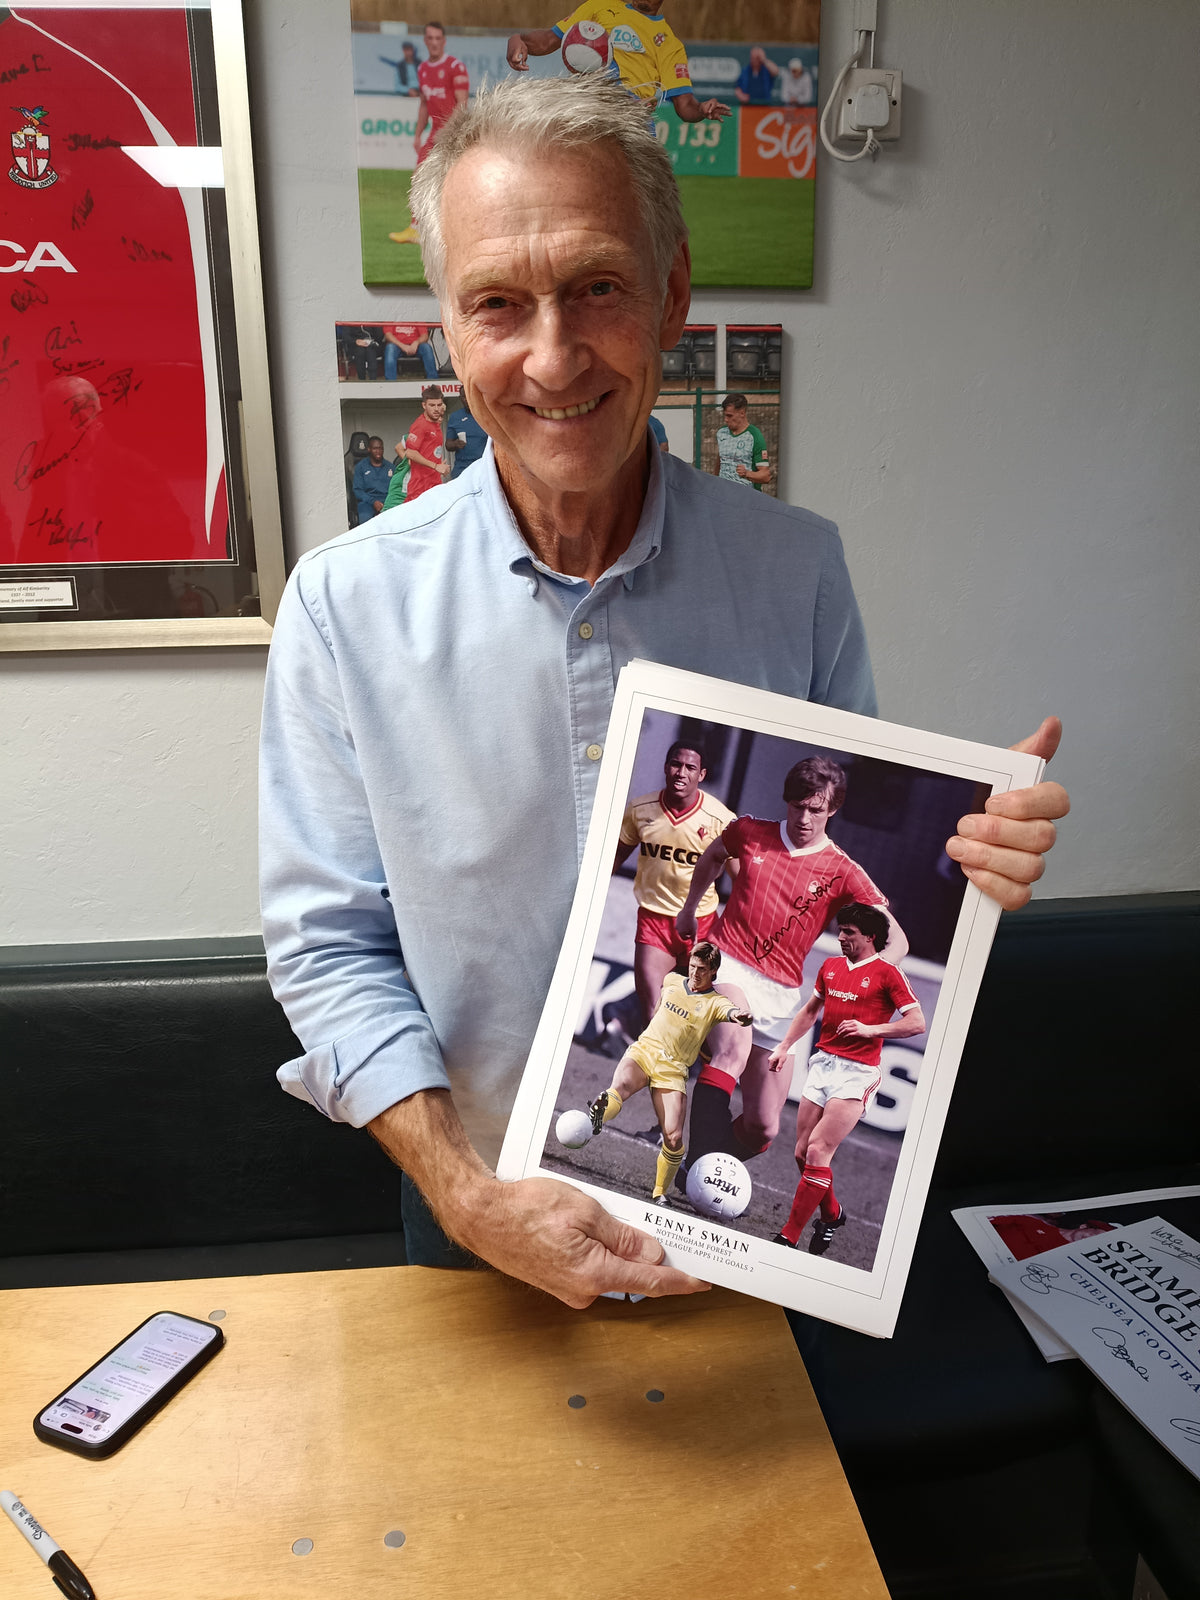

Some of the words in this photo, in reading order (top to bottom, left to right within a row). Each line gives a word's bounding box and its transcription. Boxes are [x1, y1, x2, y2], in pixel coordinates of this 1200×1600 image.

[678, 122, 722, 147] 133
[640, 841, 702, 866] IVECO
[664, 1001, 690, 1020] SKOL
[713, 1166, 723, 1177] 5
[703, 1176, 741, 1197] Mitre
[644, 1212, 695, 1236] KENNY
[700, 1230, 750, 1253] SWAIN
[656, 1227, 706, 1249] NOTTINGHAM
[706, 1243, 733, 1258] FOREST
[664, 1240, 693, 1254] LEAGUE
[693, 1248, 711, 1260] APPS
[712, 1255, 725, 1264] 112
[725, 1259, 749, 1272] GOALS
[1070, 1272, 1134, 1327] CHELSEA
[1081, 1247, 1200, 1342] BRIDGE
